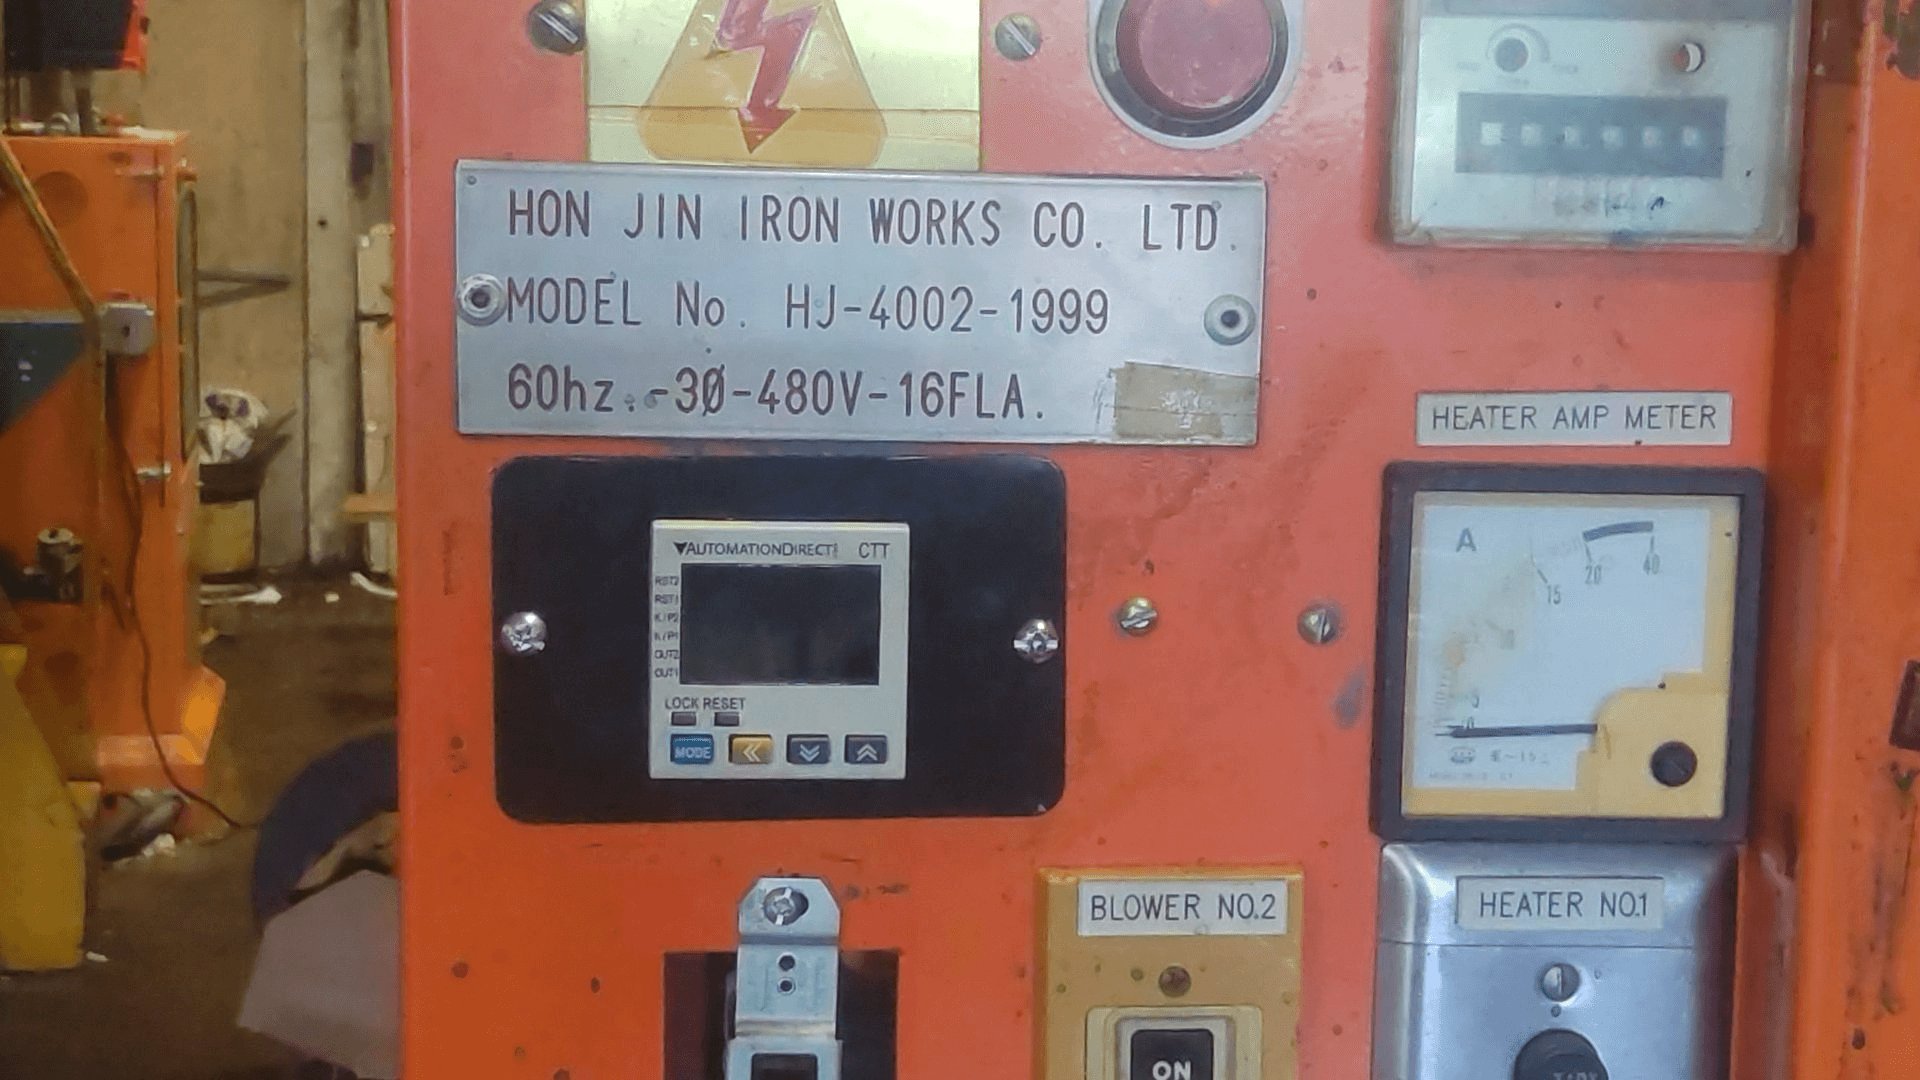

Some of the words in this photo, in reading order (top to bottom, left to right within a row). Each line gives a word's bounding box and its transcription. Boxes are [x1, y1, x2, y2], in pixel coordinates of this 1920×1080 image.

[508, 188, 591, 238] HON
[623, 192, 703, 241] JIN
[740, 194, 840, 244] IRON
[869, 198, 1002, 247] WORKS
[1033, 201, 1104, 249] CO.
[1142, 203, 1238, 252] LTD.
[506, 275, 642, 327] MODEL
[676, 279, 748, 329] No.
[785, 283, 1109, 336] HJ-4002-1999
[1432, 404, 1538, 431] HEATER
[1552, 406, 1610, 432] AMP
[1624, 406, 1717, 432] METER
[858, 542, 892, 560] CTT
[1456, 527, 1477, 552] A
[1585, 564, 1603, 585] 20
[1643, 553, 1661, 576] 40
[1546, 584, 1562, 605] 15
[664, 697, 700, 711] LOCK
[702, 698, 747, 712] RESET
[673, 744, 713, 760] MODE
[1090, 892, 1202, 922] BLOWER
[1217, 894, 1277, 922] NO.2
[1479, 891, 1584, 919] HEATER
[1600, 893, 1649, 919] NO.1
[1152, 1060, 1192, 1080] ON
